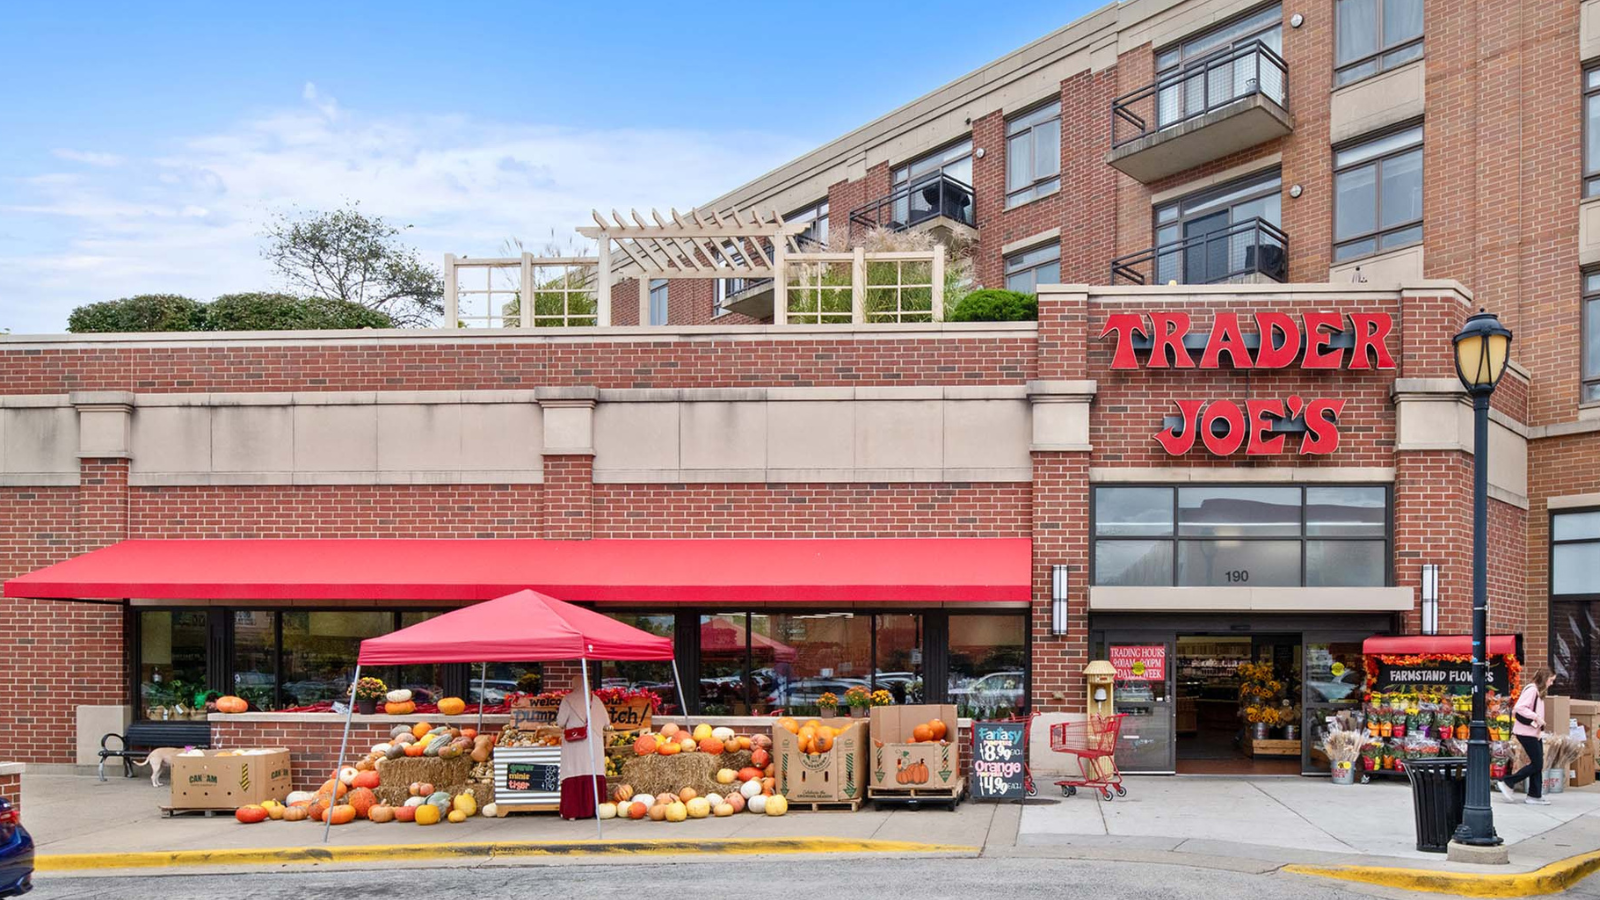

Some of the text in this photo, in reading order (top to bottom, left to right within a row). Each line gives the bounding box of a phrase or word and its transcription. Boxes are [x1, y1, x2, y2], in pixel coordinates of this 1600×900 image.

[1099, 310, 1397, 370] TRADER
[1153, 395, 1347, 456] JOE'S
[1225, 570, 1249, 582] 190
[1110, 648, 1165, 657] TRADING HOURS
[1143, 669, 1161, 678] WEEK
[1390, 670, 1494, 682] FARMSTAND FLOWS
[529, 697, 561, 706] welco
[512, 702, 650, 729] pump tch!
[978, 726, 1022, 744] Fantasy
[979, 742, 1012, 760] $8.99
[975, 760, 1021, 778] Orange
[508, 780, 530, 790] tiger
[979, 775, 1008, 796] $4.99
